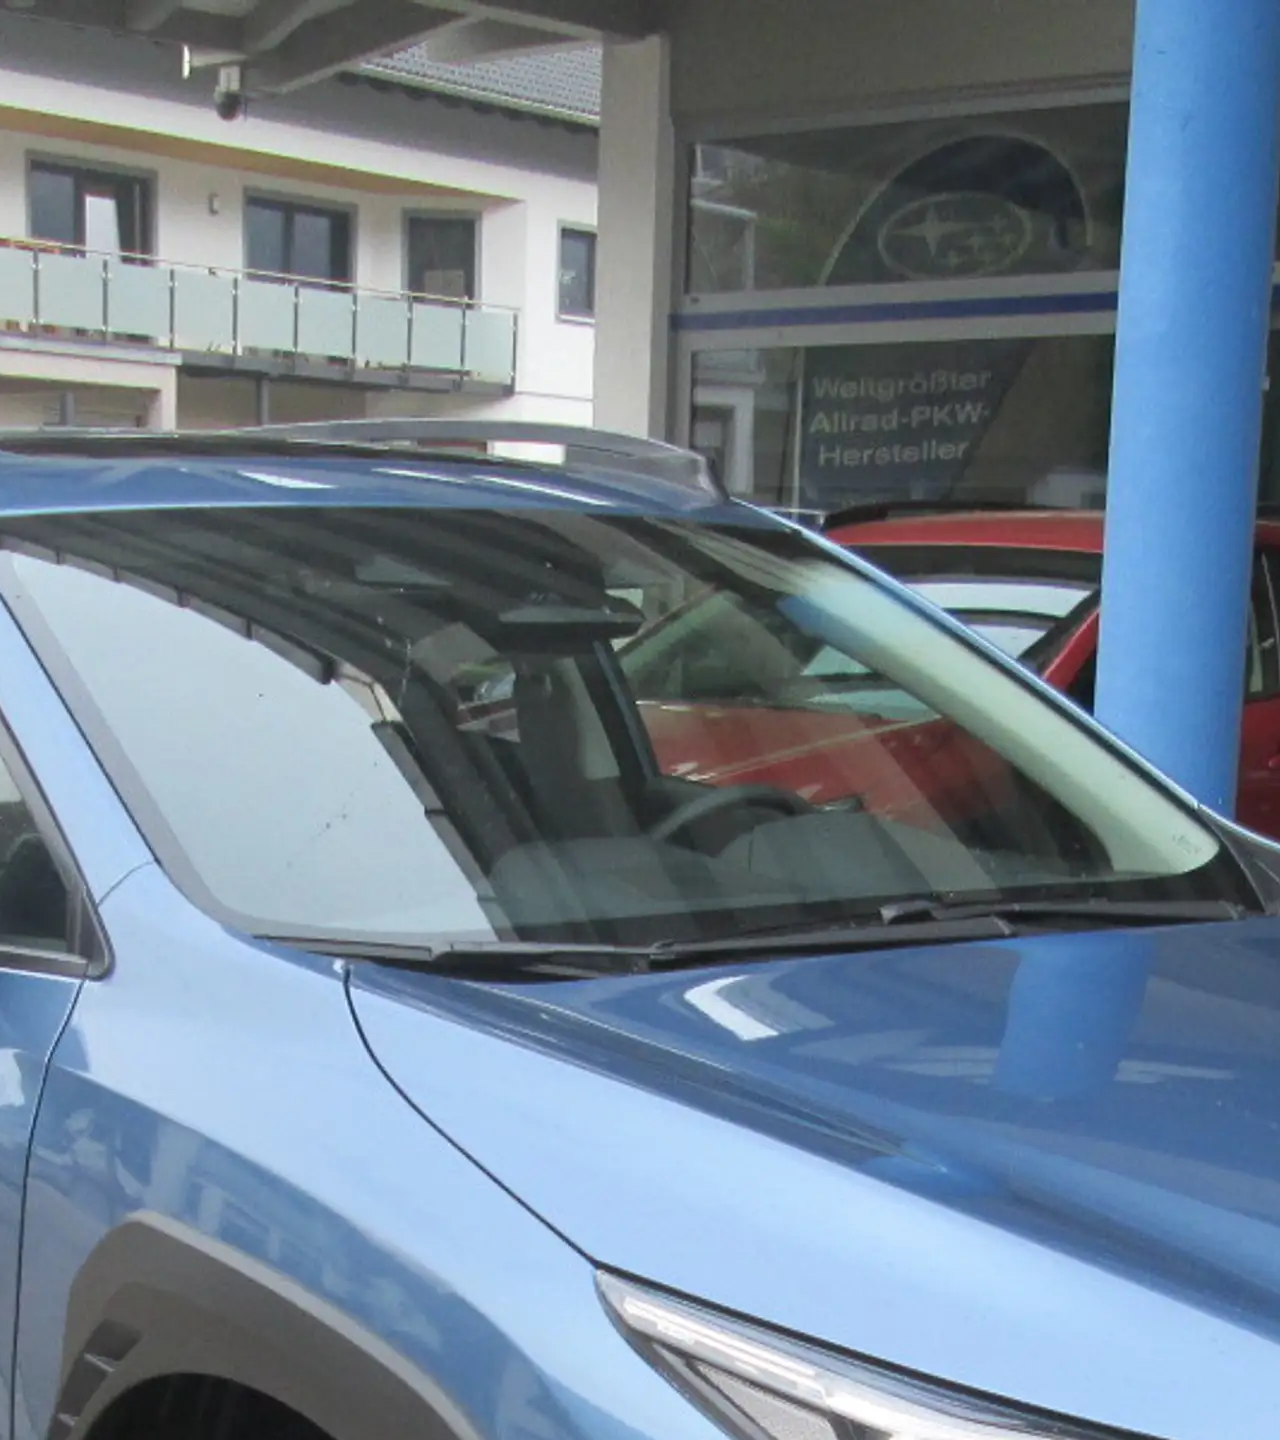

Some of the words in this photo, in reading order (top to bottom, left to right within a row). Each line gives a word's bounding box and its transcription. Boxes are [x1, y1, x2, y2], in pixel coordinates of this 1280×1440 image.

[812, 369, 992, 403] Weltgrößter
[810, 400, 990, 434] Allrad-PKW-
[817, 438, 969, 468] Hersteller
